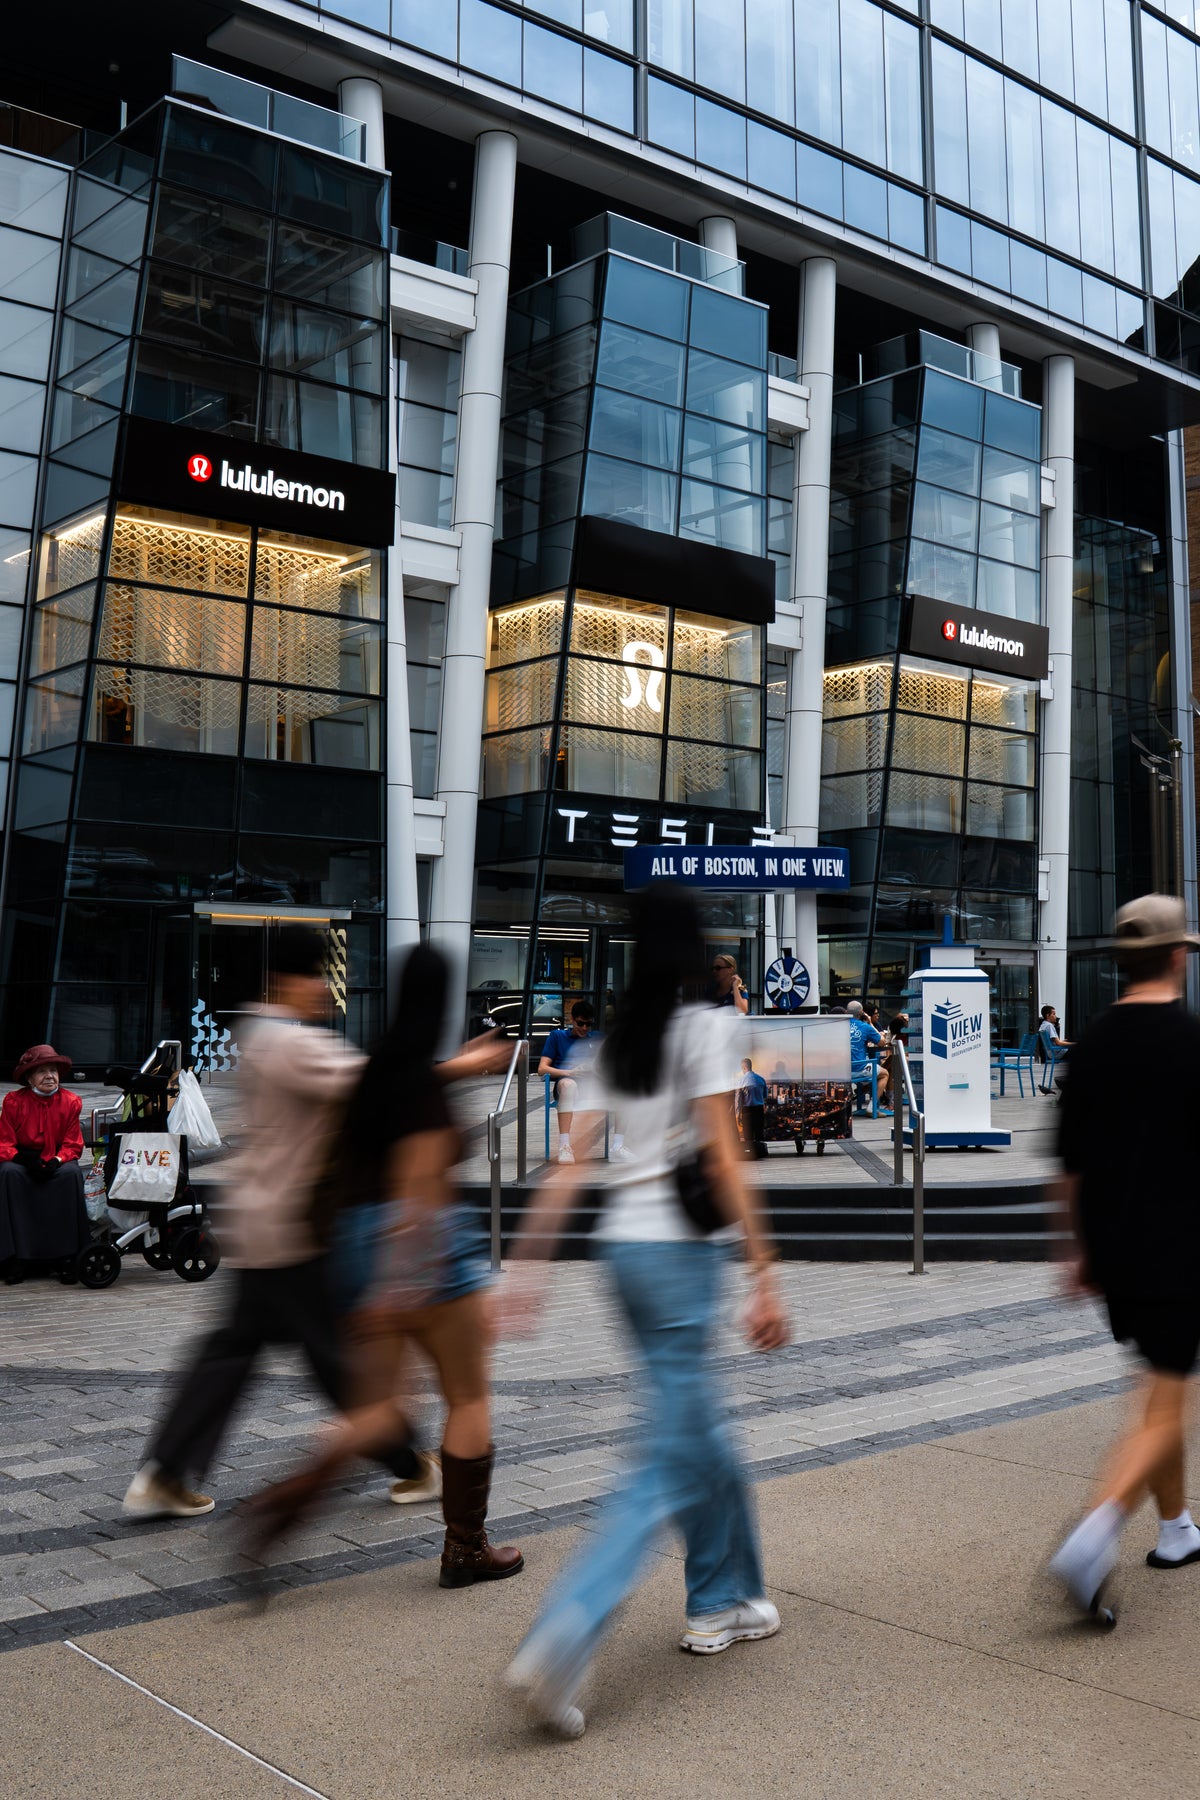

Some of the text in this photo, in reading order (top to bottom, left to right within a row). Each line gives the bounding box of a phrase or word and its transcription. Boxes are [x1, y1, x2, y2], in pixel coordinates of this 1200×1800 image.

[220, 460, 345, 511] lululemon
[959, 623, 1024, 657] lululemon
[651, 857, 845, 878] ALL OF BOSTON, IN ONE VIEW.
[951, 1013, 982, 1040] VIEW
[951, 1032, 982, 1049] BOSTON
[121, 1149, 171, 1167] GIVE
